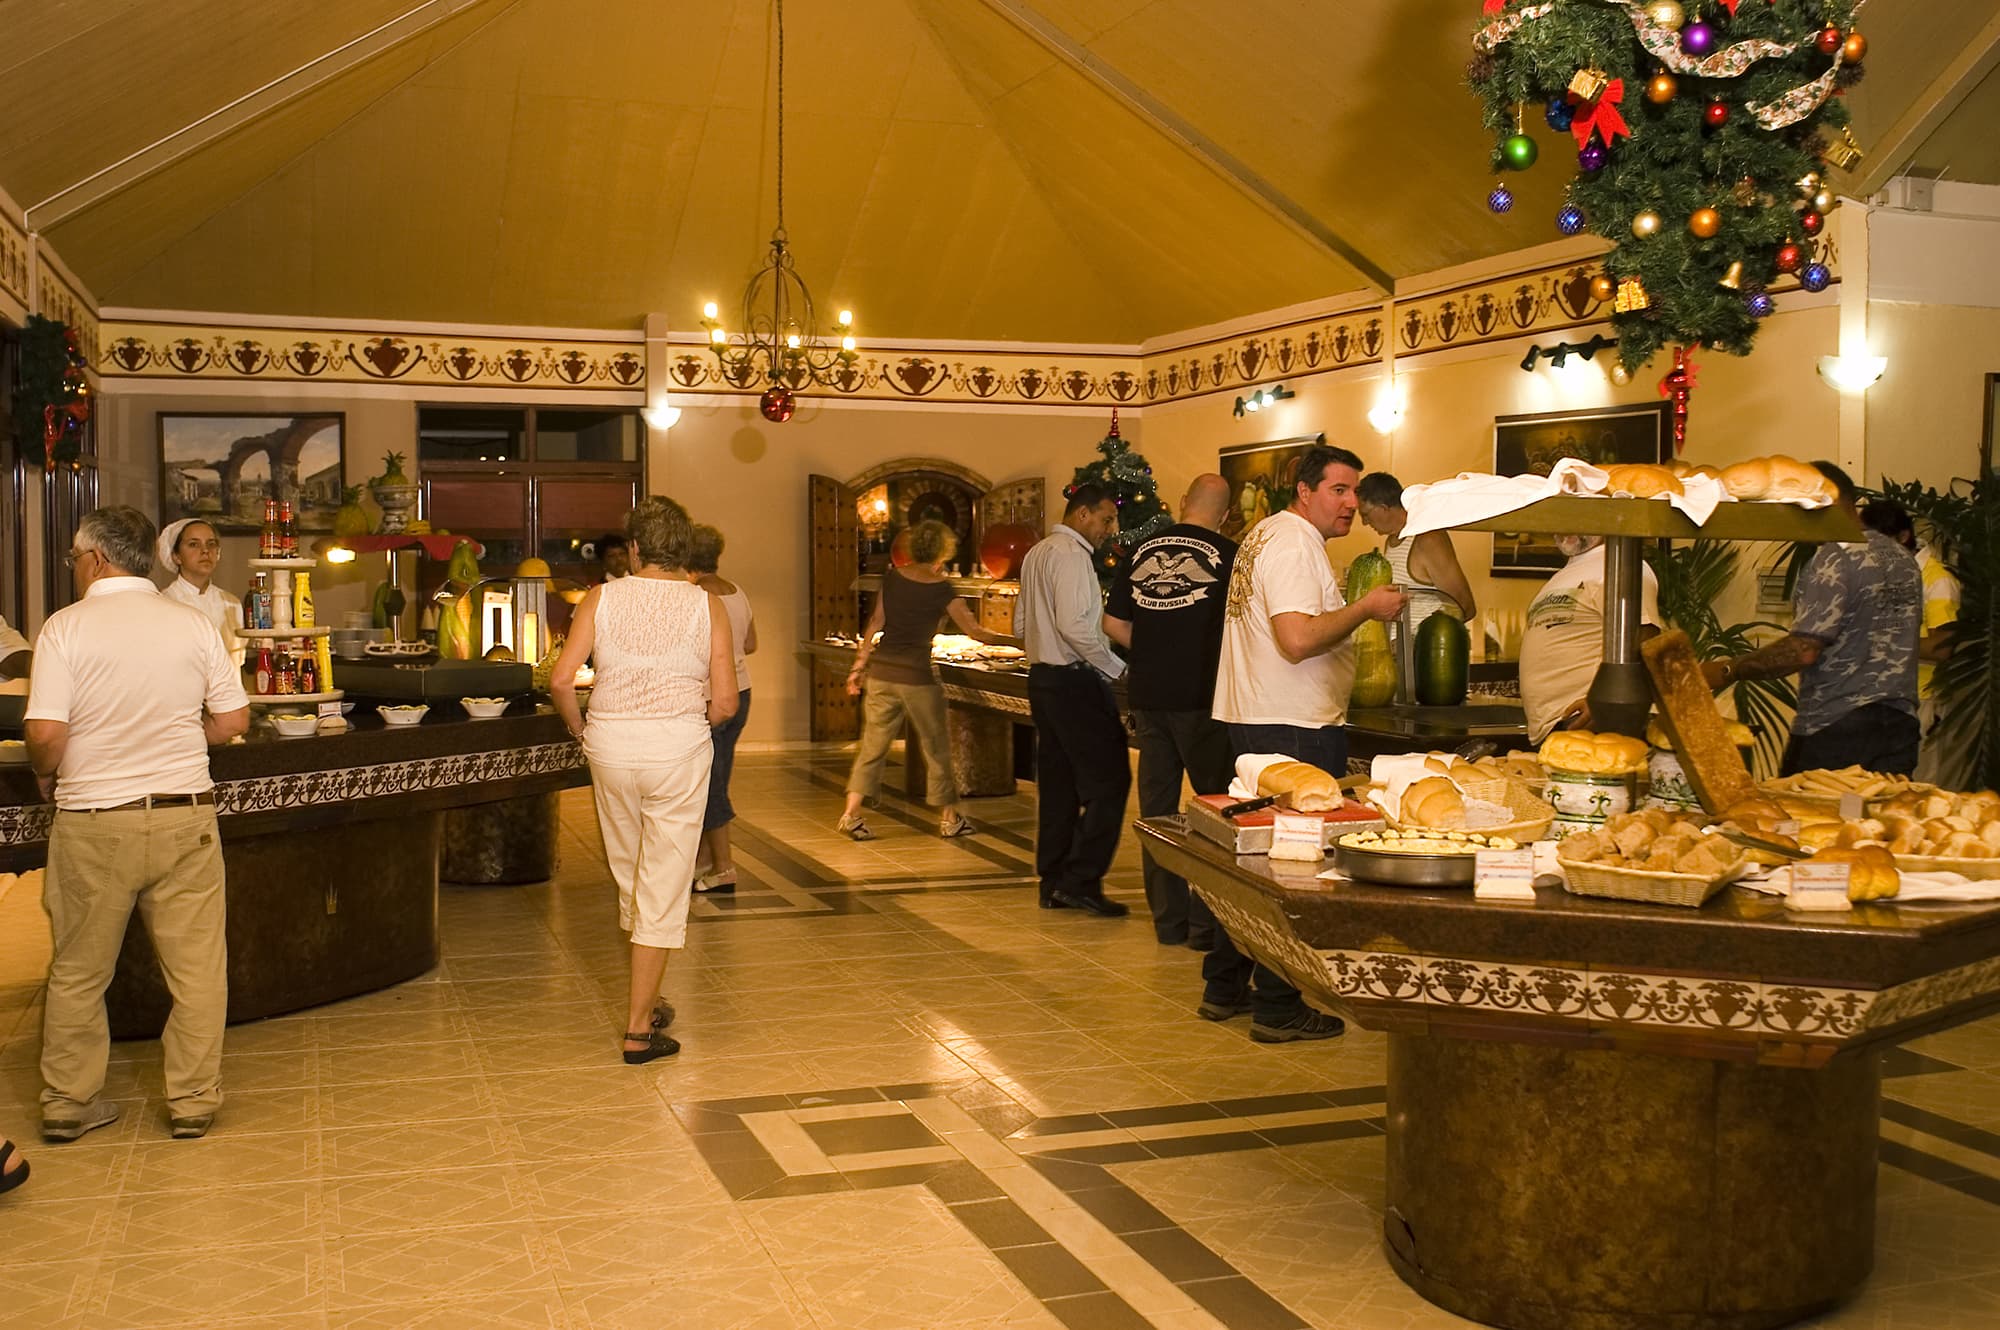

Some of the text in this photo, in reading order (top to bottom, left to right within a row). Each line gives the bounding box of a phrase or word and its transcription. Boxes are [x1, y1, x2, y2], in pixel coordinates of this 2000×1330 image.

[1140, 538, 1217, 555] HARLEY-DAVIDSON
[1140, 598, 1188, 608] CLUB RUSSIA
